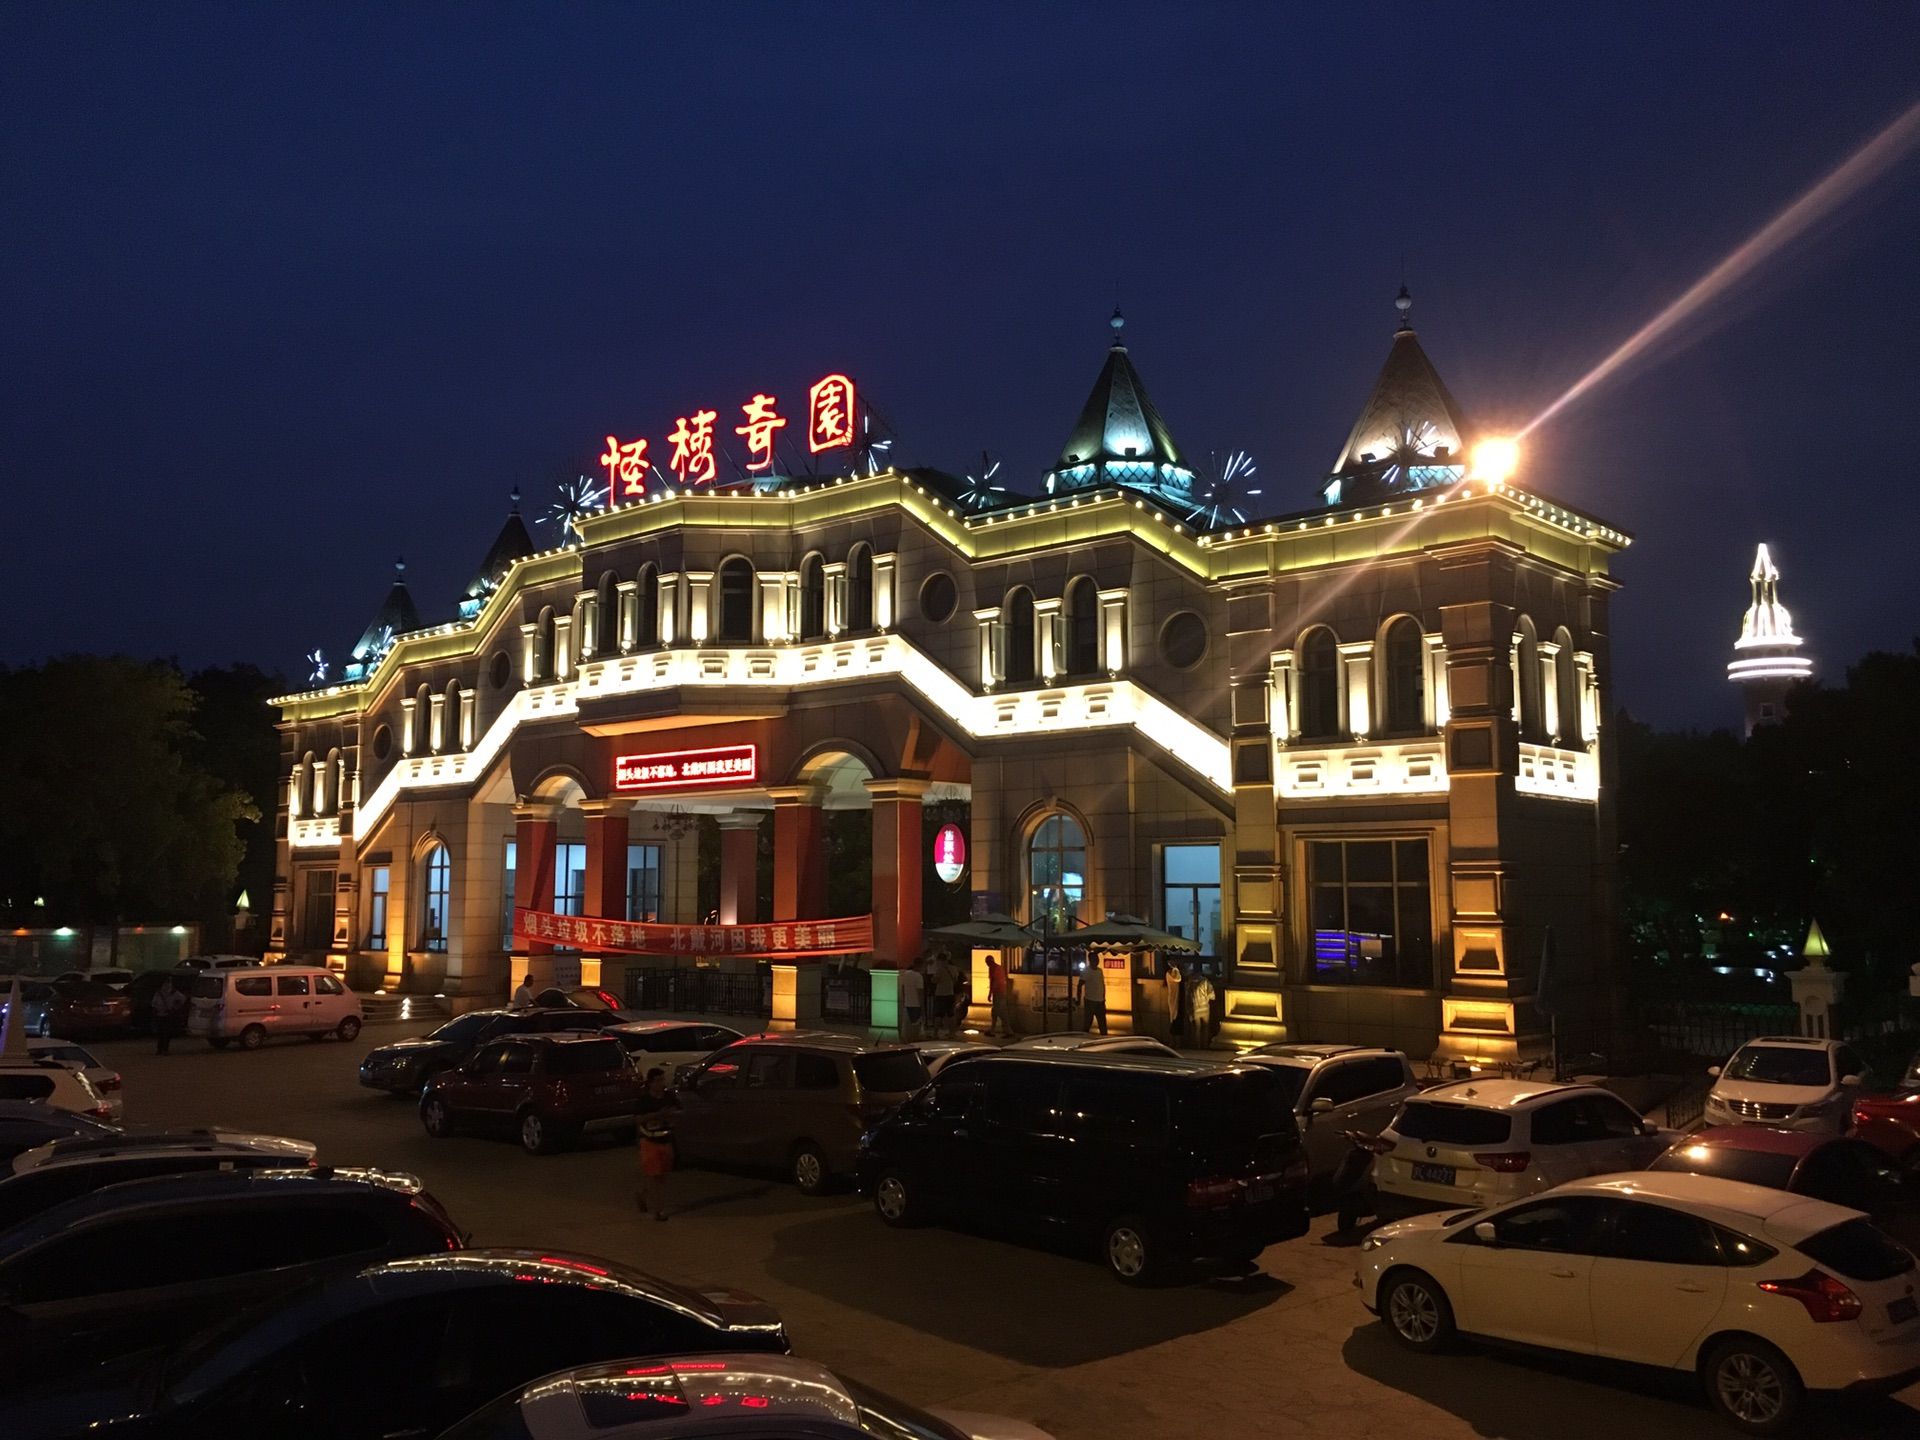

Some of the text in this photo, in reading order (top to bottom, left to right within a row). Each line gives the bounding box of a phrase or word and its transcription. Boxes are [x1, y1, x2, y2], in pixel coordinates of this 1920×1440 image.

[523, 911, 836, 951] 烟头垃圾不落地 北戴河因我更美丽
